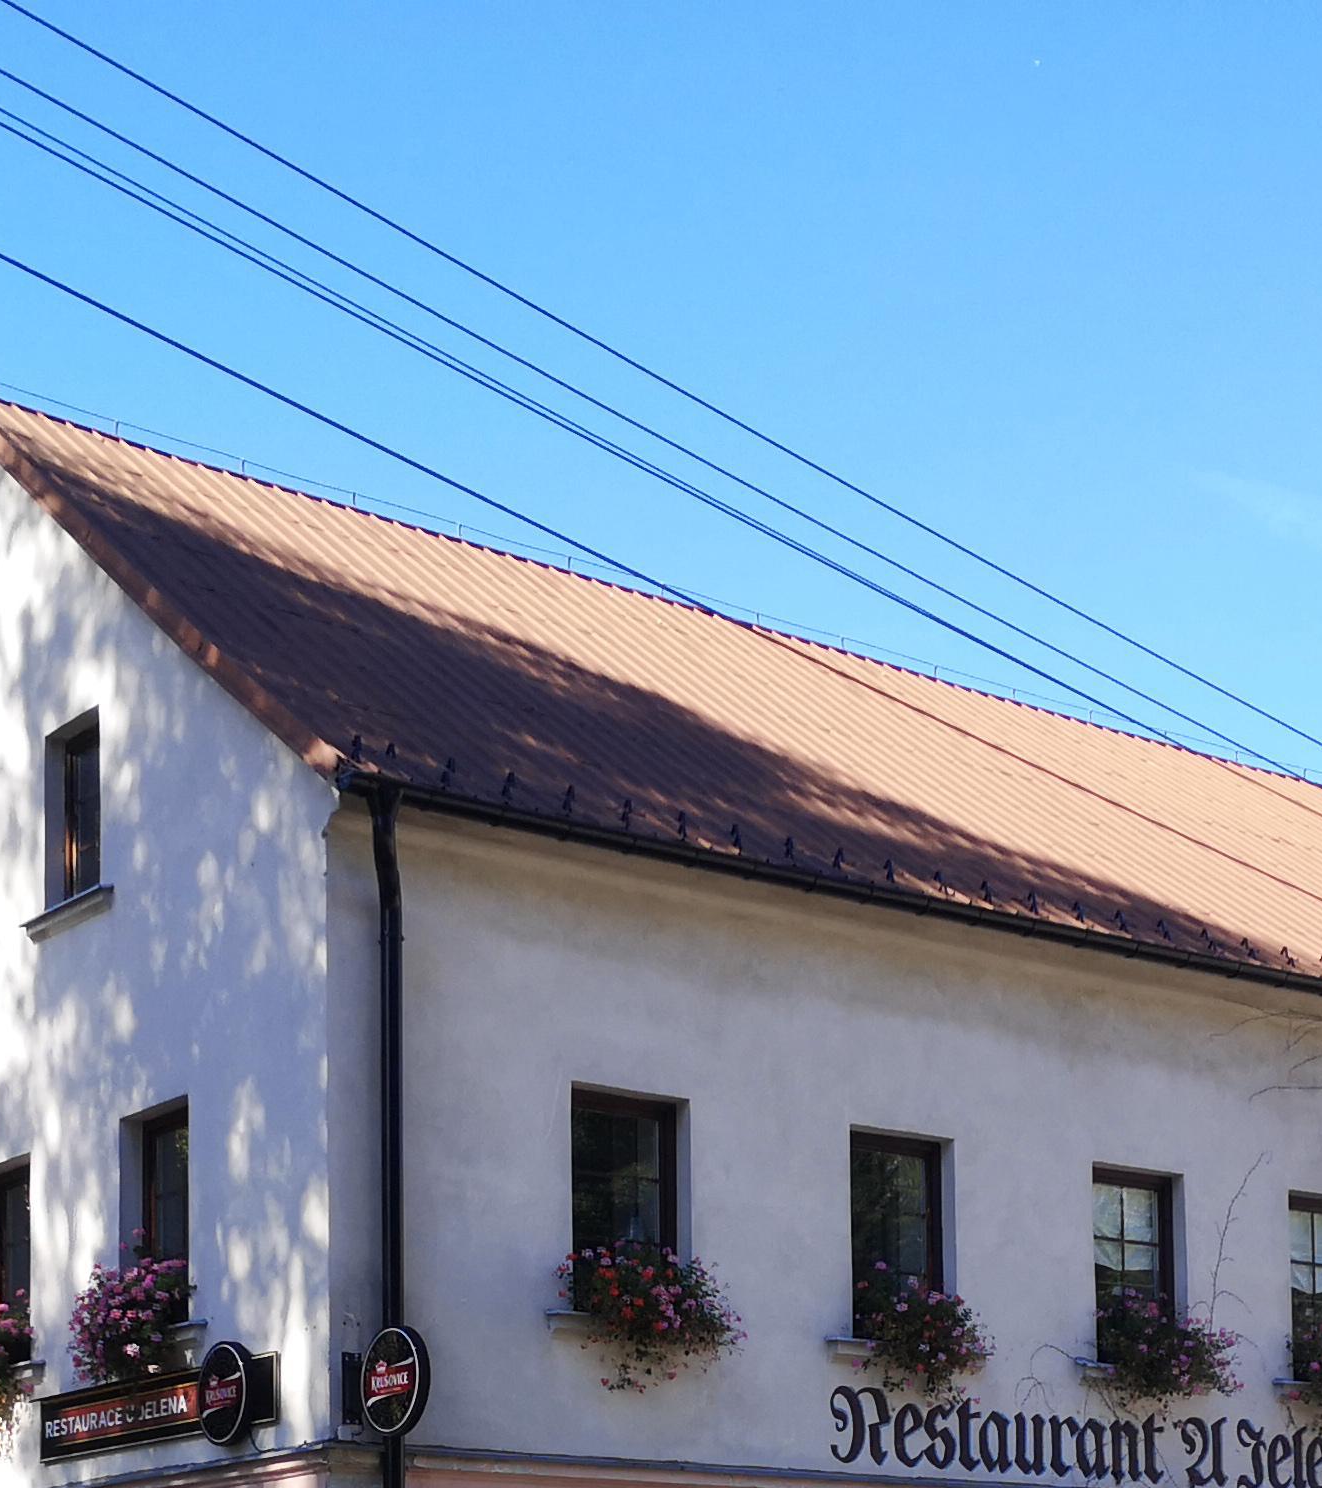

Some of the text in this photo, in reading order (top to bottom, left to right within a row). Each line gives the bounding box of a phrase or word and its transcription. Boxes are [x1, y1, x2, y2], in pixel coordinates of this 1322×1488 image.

[45, 1407, 124, 1439] RESTAURACE
[138, 1394, 188, 1421] JELENA
[830, 1385, 1164, 1484] Restaurant
